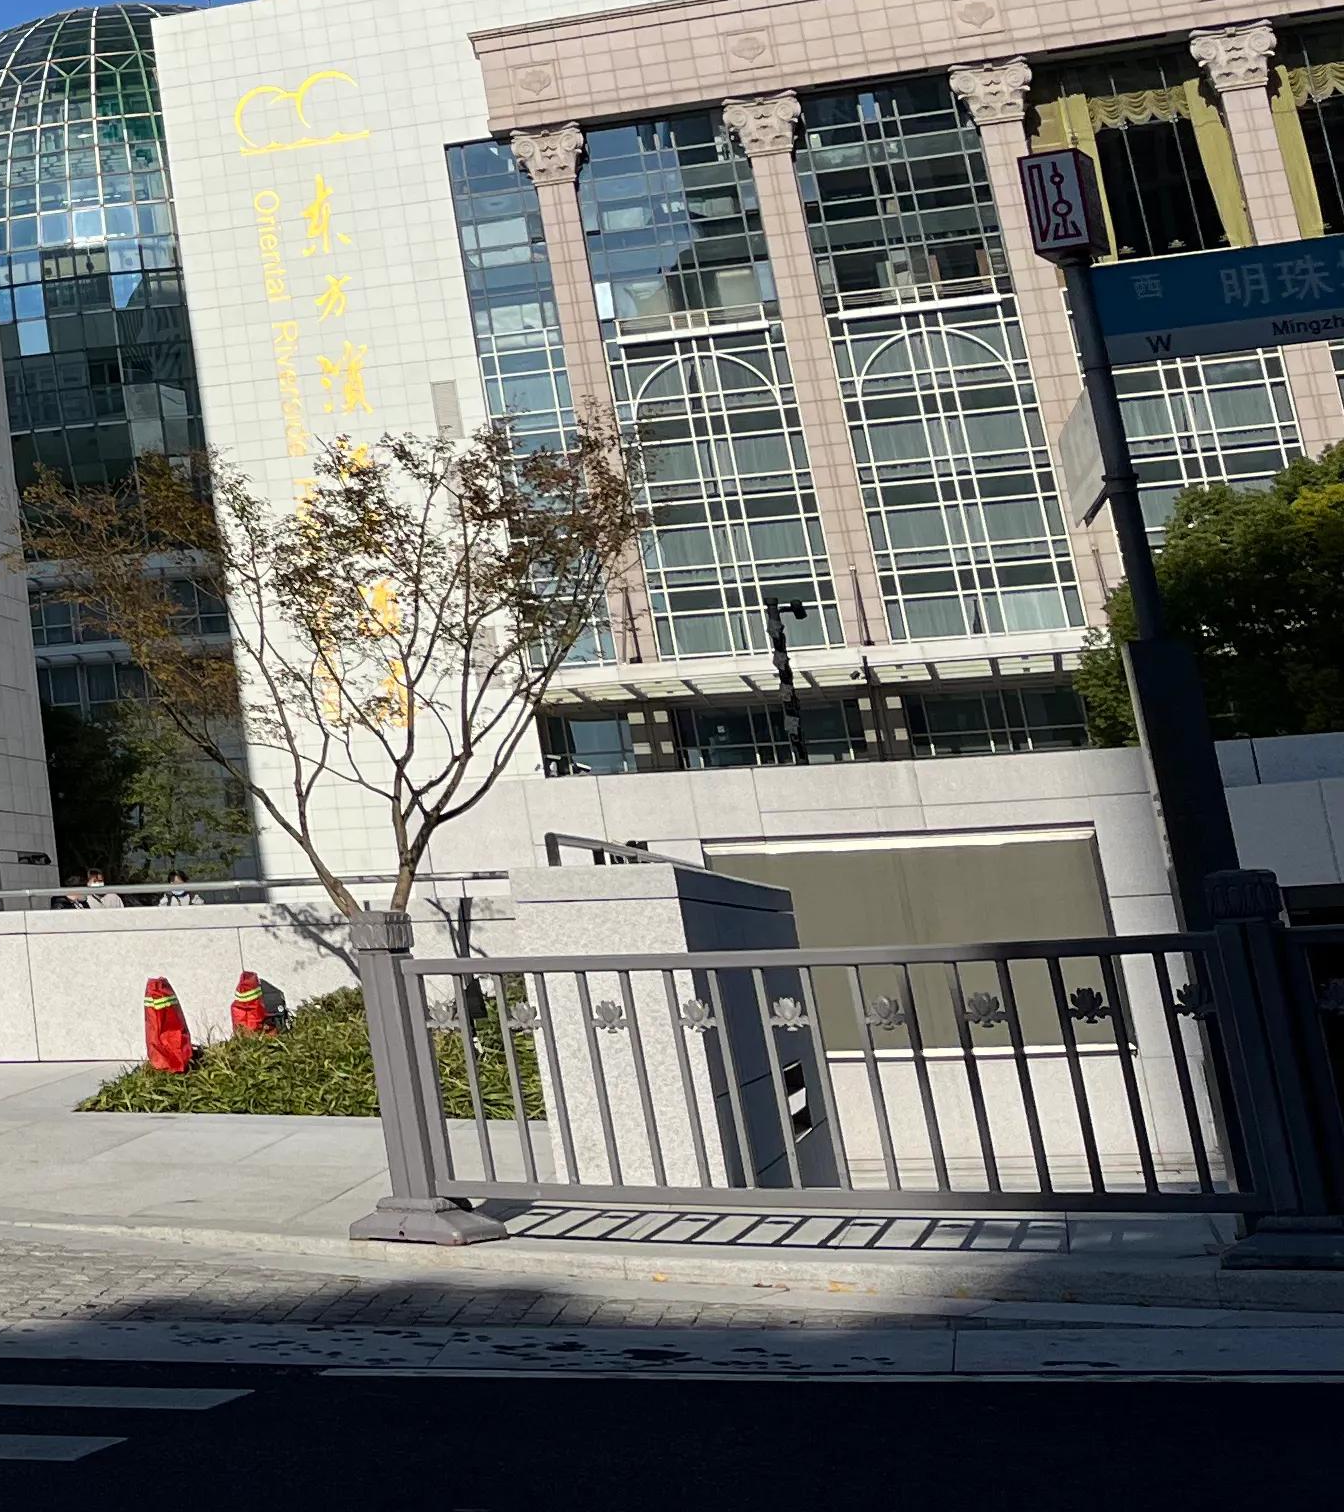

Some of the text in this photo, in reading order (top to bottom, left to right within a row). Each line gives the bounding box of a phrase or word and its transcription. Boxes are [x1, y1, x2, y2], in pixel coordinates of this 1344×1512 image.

[254, 190, 292, 304] Oriental
[1219, 250, 1344, 308] 明珠
[1146, 334, 1172, 355] W
[272, 320, 313, 458] Riverside
